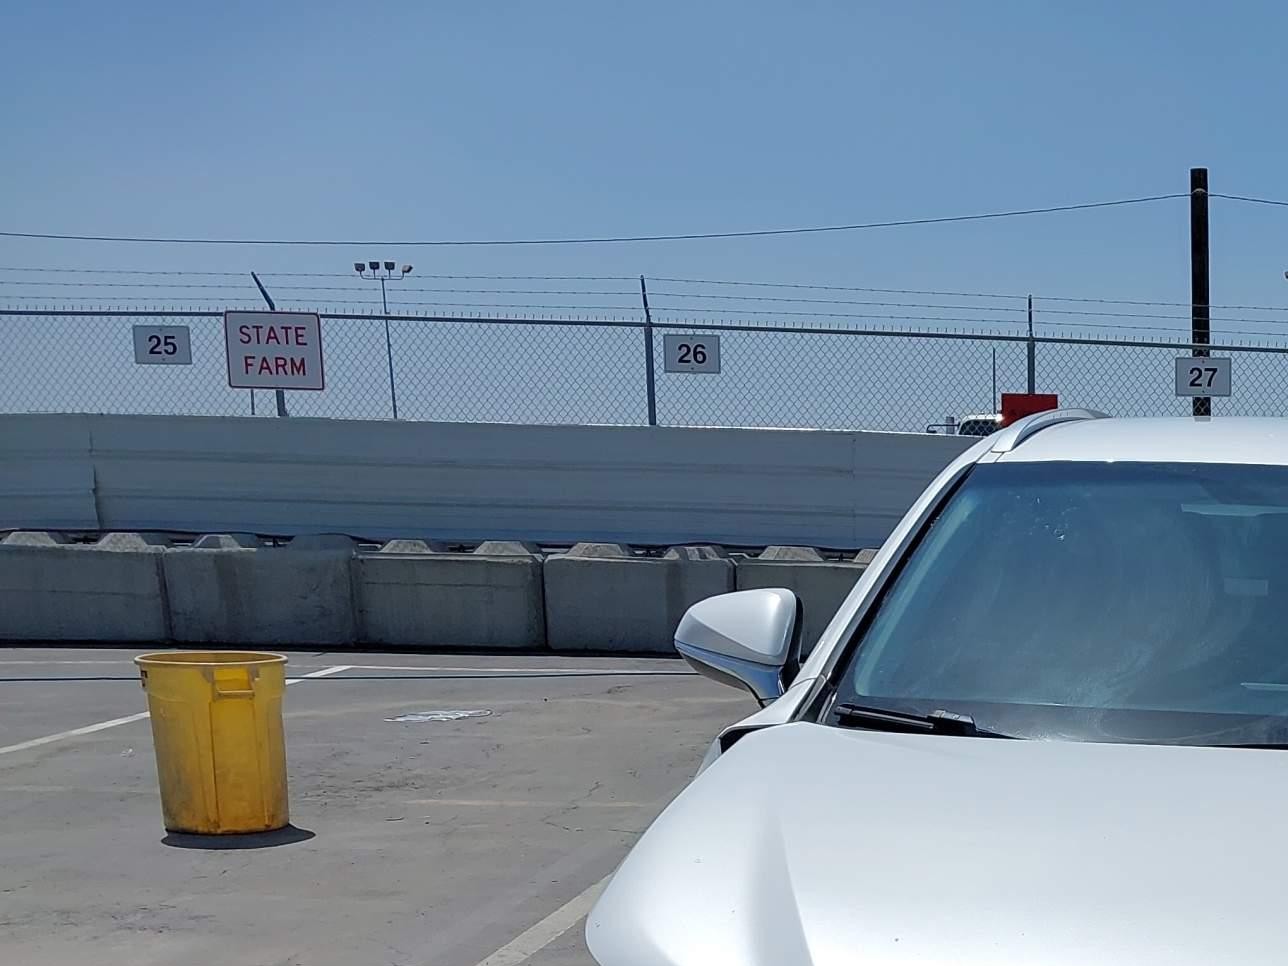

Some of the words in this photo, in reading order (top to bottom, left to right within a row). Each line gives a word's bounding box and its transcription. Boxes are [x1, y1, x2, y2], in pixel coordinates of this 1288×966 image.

[147, 334, 178, 356] 25
[238, 324, 309, 347] STATE
[677, 343, 707, 365] 26
[242, 355, 308, 378] FARM
[1188, 367, 1218, 388] 27
